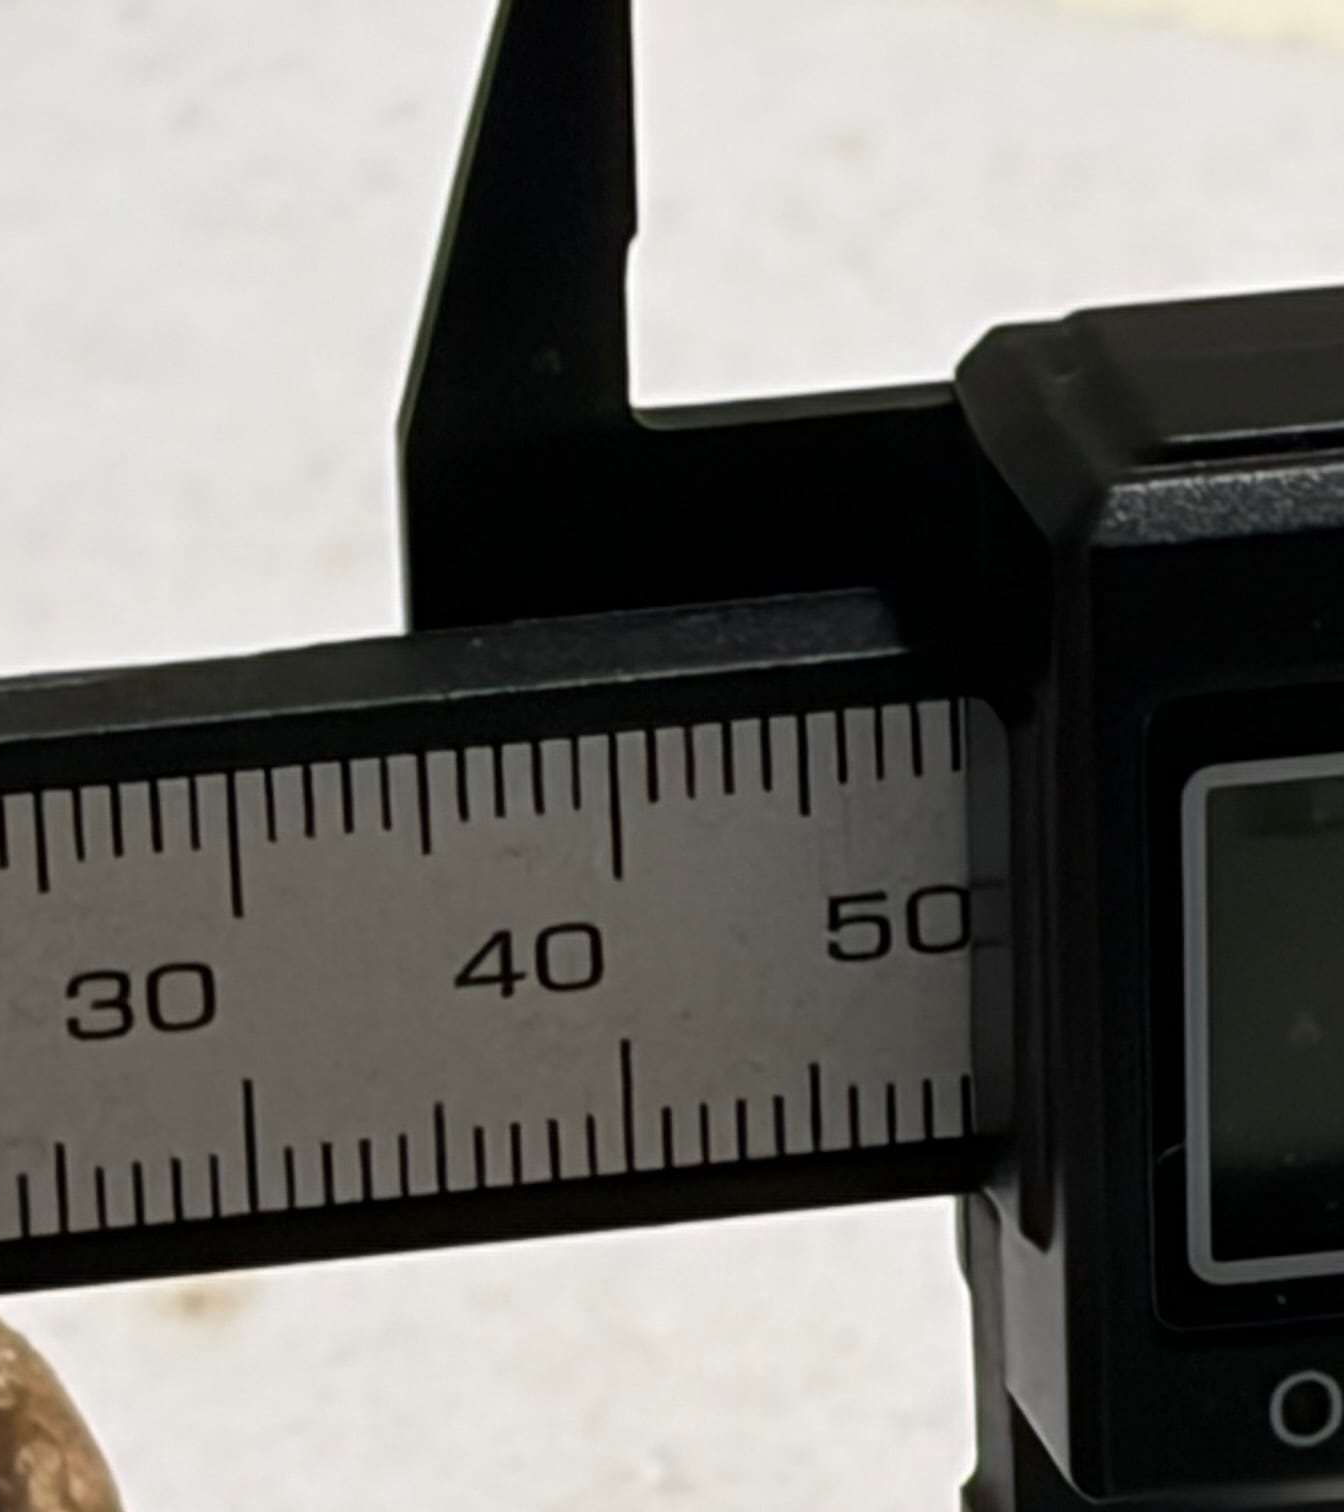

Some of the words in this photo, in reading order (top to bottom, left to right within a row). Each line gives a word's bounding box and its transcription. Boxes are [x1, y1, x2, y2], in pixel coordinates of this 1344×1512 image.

[64, 962, 217, 1041] 30
[455, 922, 604, 999] 40
[826, 884, 972, 963] 50
